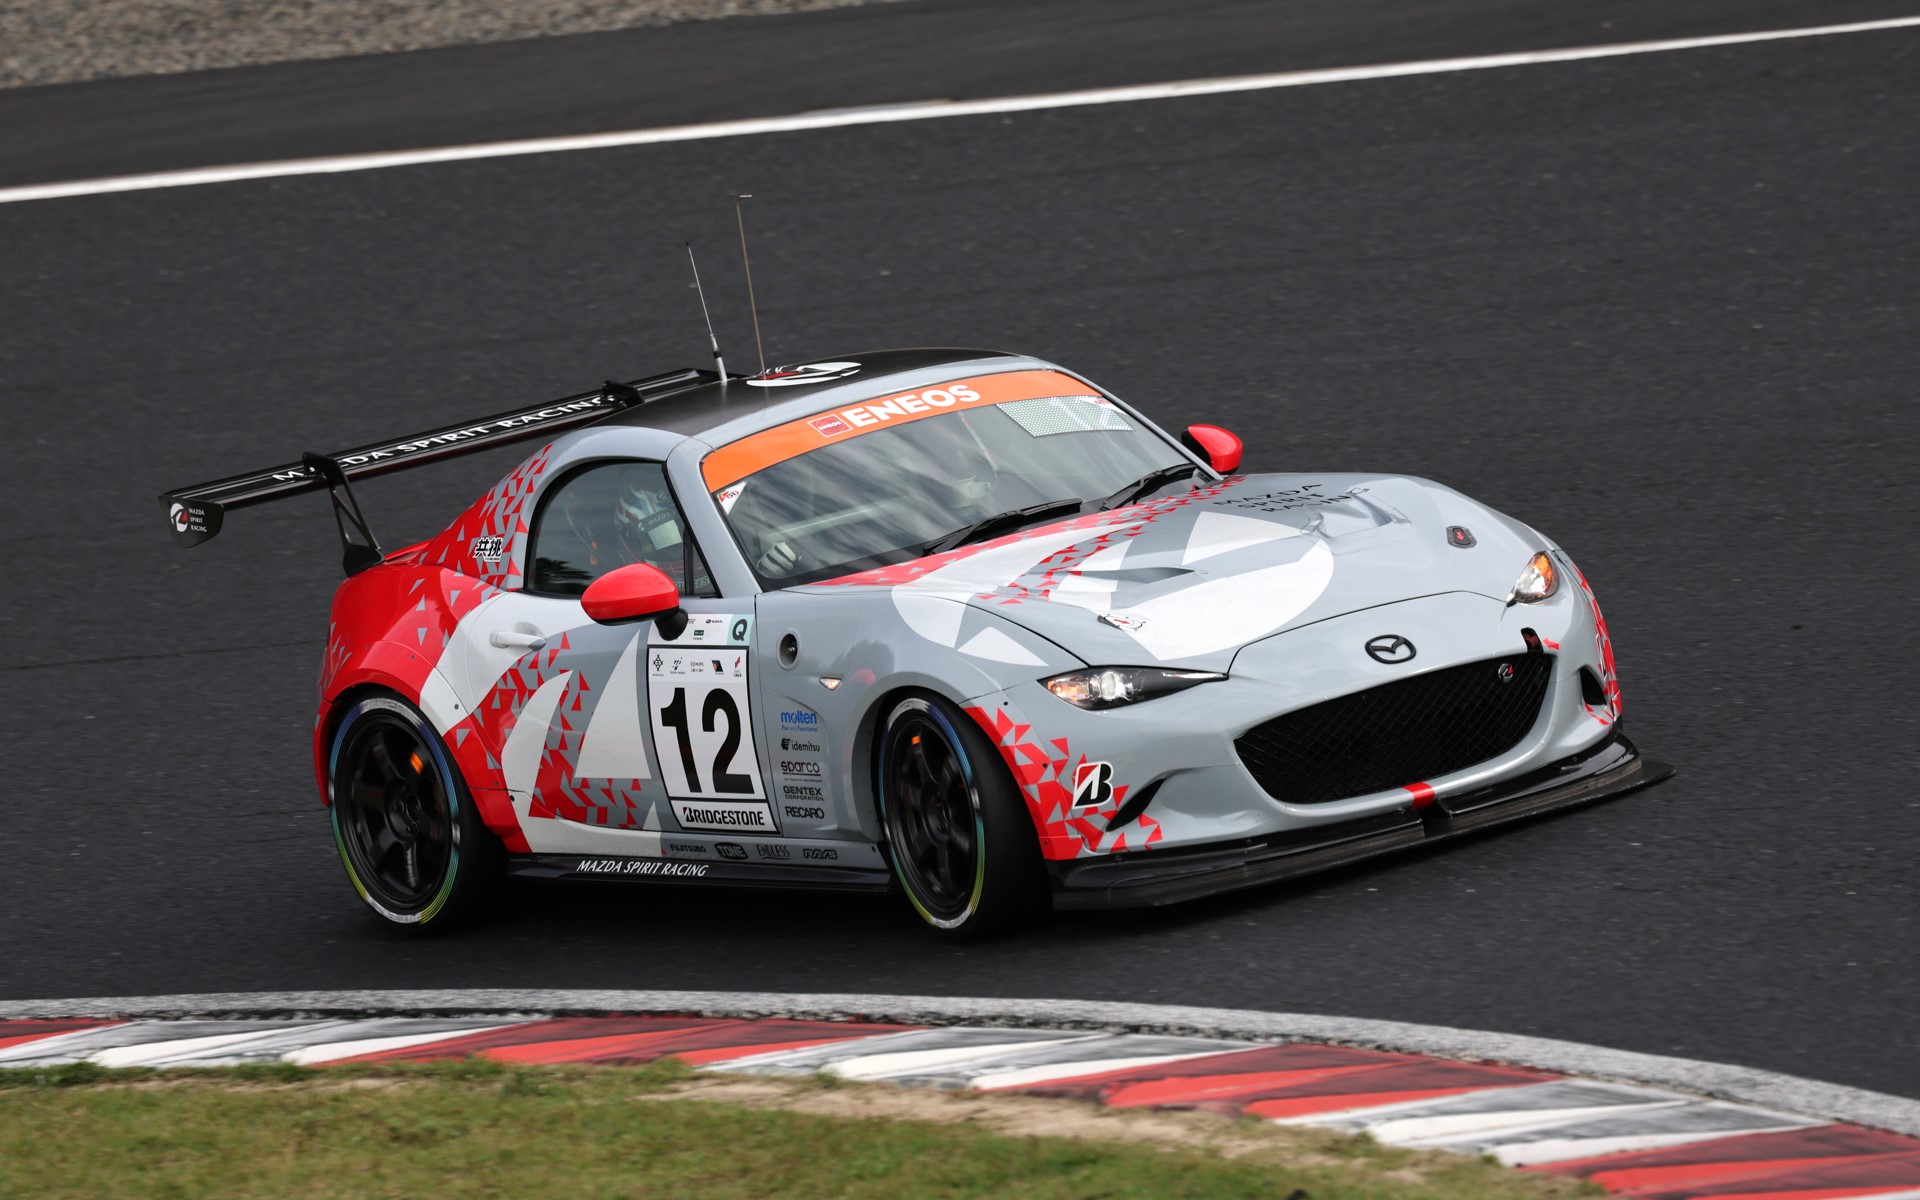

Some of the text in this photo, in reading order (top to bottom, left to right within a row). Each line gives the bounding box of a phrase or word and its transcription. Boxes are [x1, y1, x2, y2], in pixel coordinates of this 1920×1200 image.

[840, 385, 981, 427] ENEOS
[818, 420, 842, 431] ENEOS
[397, 426, 489, 453] SPIRIT
[1214, 483, 1322, 506] MAZDA
[1238, 492, 1324, 509] SPIRIT
[189, 508, 205, 516] MAZDA
[475, 538, 502, 557] 共挑
[732, 618, 748, 641] Q
[781, 710, 817, 724] molten
[661, 687, 755, 794] 12
[791, 740, 821, 752] idemitsu
[781, 761, 820, 775] sparco
[783, 785, 823, 796] GENTEX
[683, 807, 766, 826] BRIDGESTONE
[785, 806, 825, 819] RECARO
[670, 844, 707, 853] FUJITSUBO
[717, 845, 746, 858] TONE
[756, 844, 791, 857] ENDLESS
[803, 849, 838, 859] RAYS
[577, 860, 709, 876] MAZDA SPIRIT RACING
